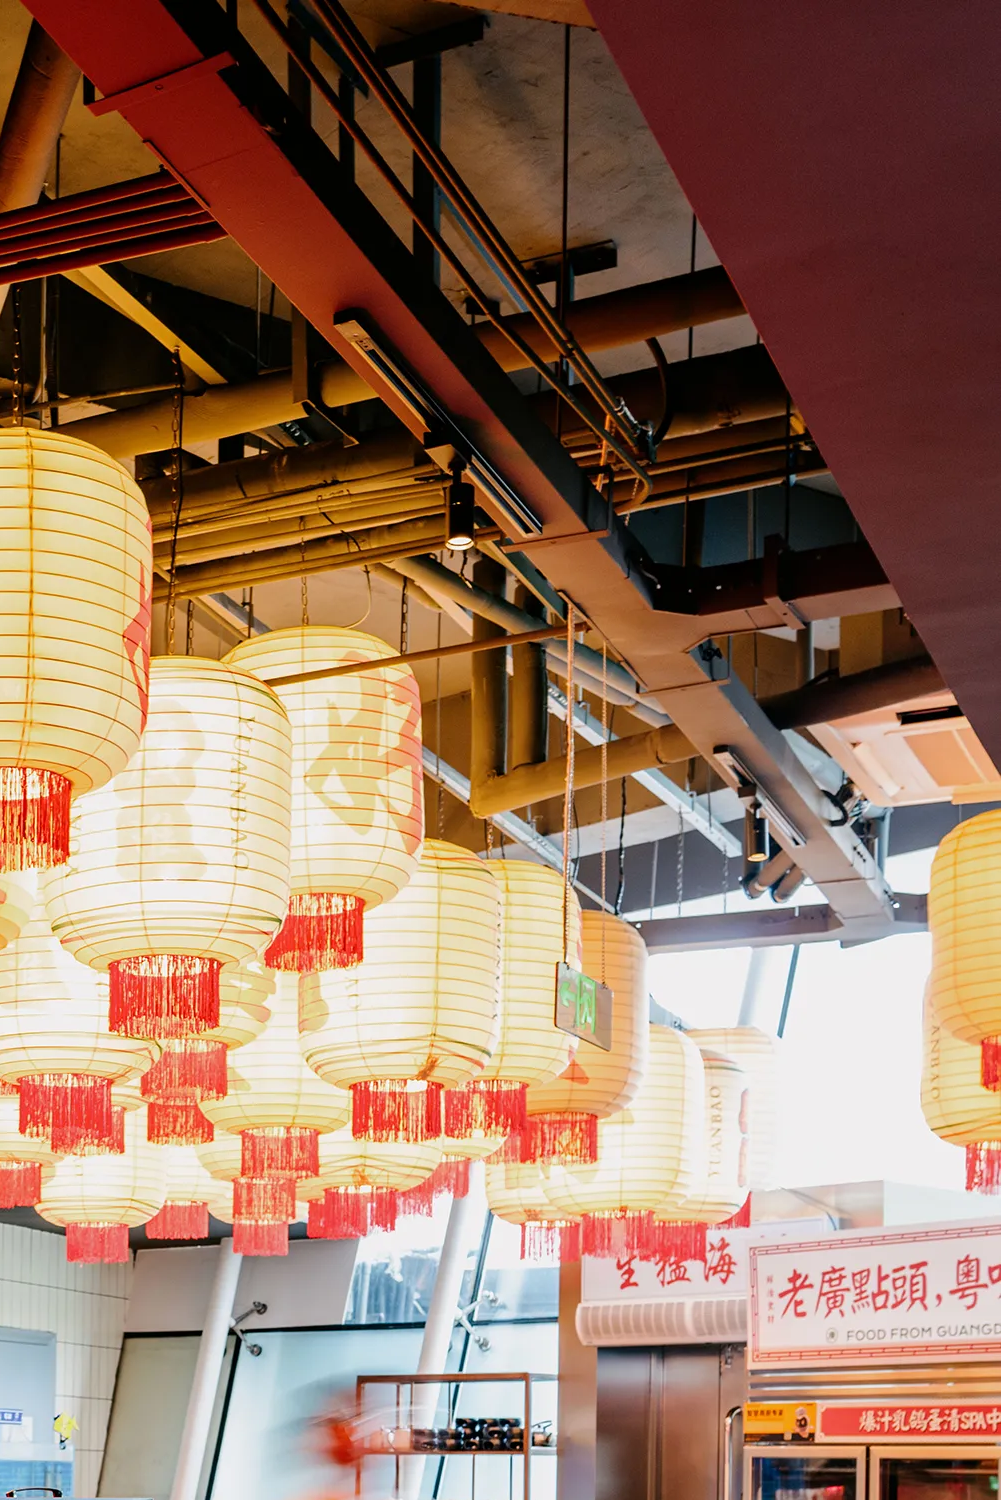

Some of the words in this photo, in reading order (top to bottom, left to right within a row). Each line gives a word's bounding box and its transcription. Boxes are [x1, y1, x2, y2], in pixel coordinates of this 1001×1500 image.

[230, 716, 255, 871] YUANBAO
[846, 1329, 887, 1342] FOOD
[891, 1327, 932, 1340] FROM
